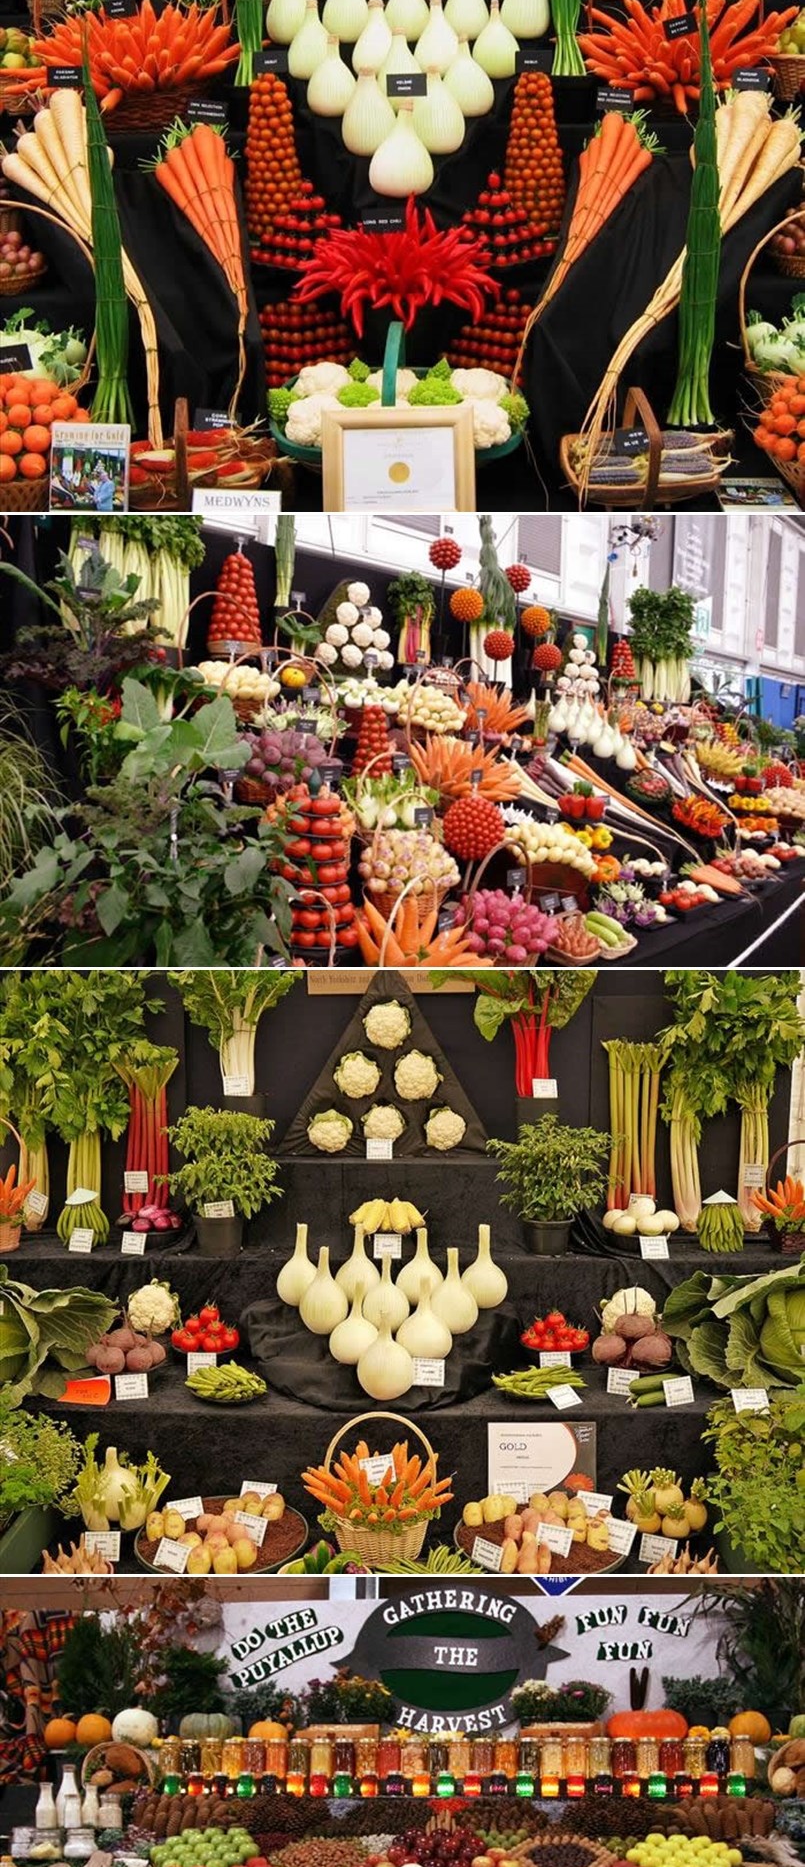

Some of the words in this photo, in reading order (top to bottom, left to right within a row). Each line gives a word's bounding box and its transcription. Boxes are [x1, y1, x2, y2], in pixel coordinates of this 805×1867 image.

[204, 495, 270, 507] MEDWYNS
[499, 1442, 527, 1451] GOLD
[382, 1589, 518, 1626] GATHERING
[578, 1605, 626, 1632] FUN
[642, 1607, 692, 1636] FUN
[232, 1631, 262, 1660] DO
[268, 1608, 316, 1639] THE
[236, 1626, 341, 1688] PUYALLUP
[434, 1646, 478, 1667] THE
[602, 1640, 652, 1661] FUN
[396, 1704, 508, 1734] HARVEST
